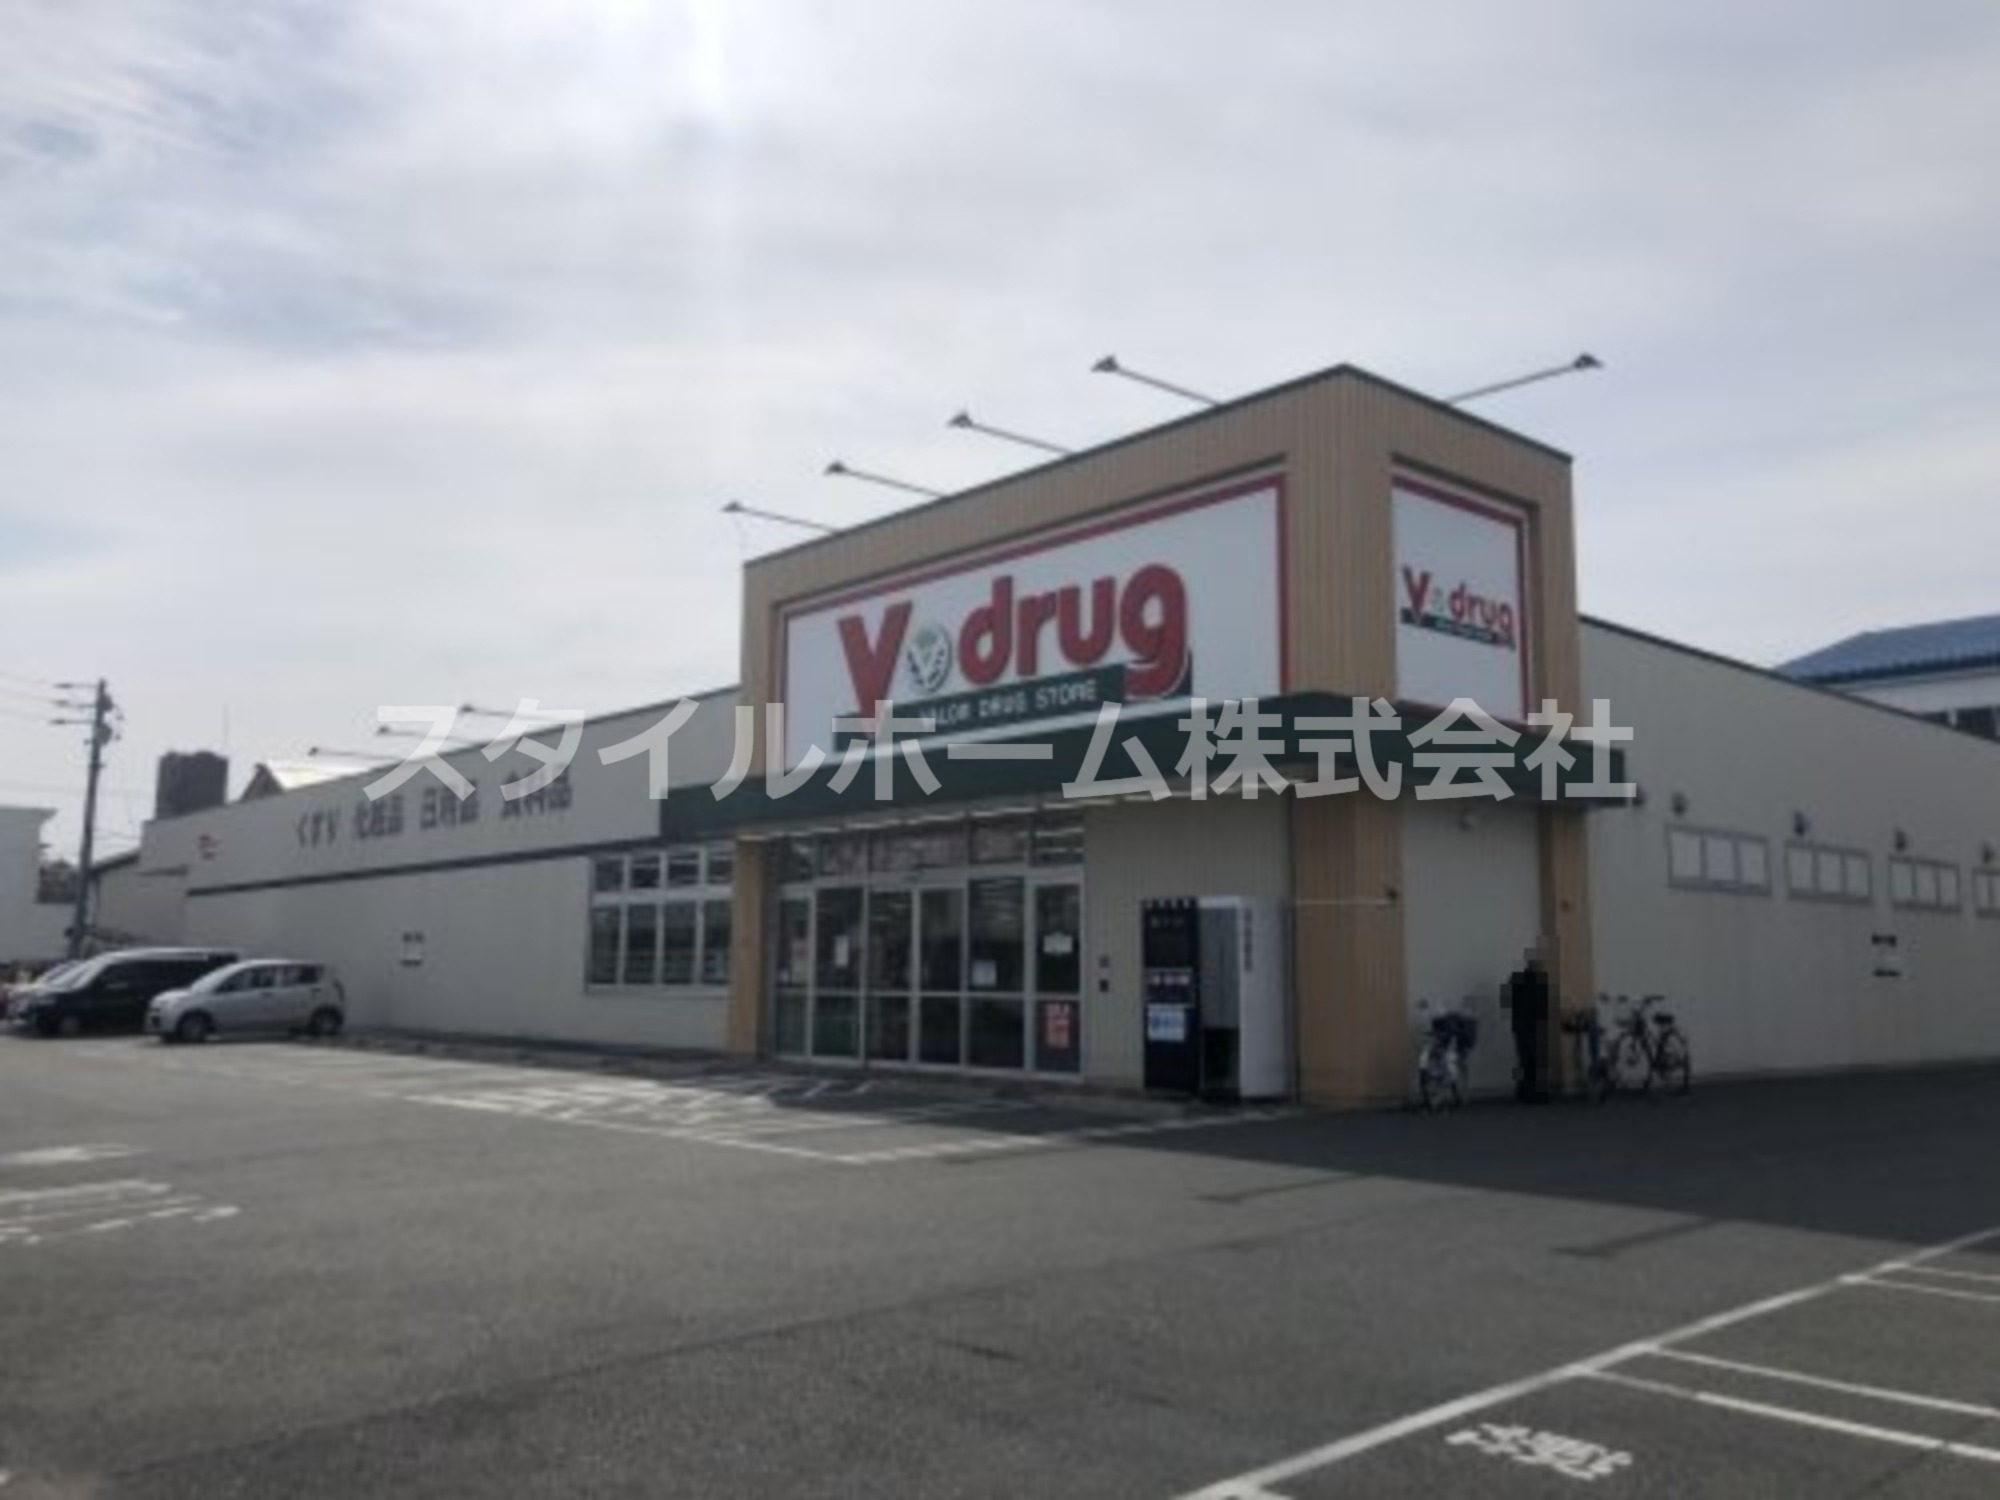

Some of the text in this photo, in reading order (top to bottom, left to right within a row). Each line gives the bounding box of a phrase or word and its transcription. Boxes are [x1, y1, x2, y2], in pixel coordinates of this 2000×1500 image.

[958, 563, 1188, 698] drug
[1449, 582, 1514, 645] drug
[1035, 679, 1097, 709] STORE
